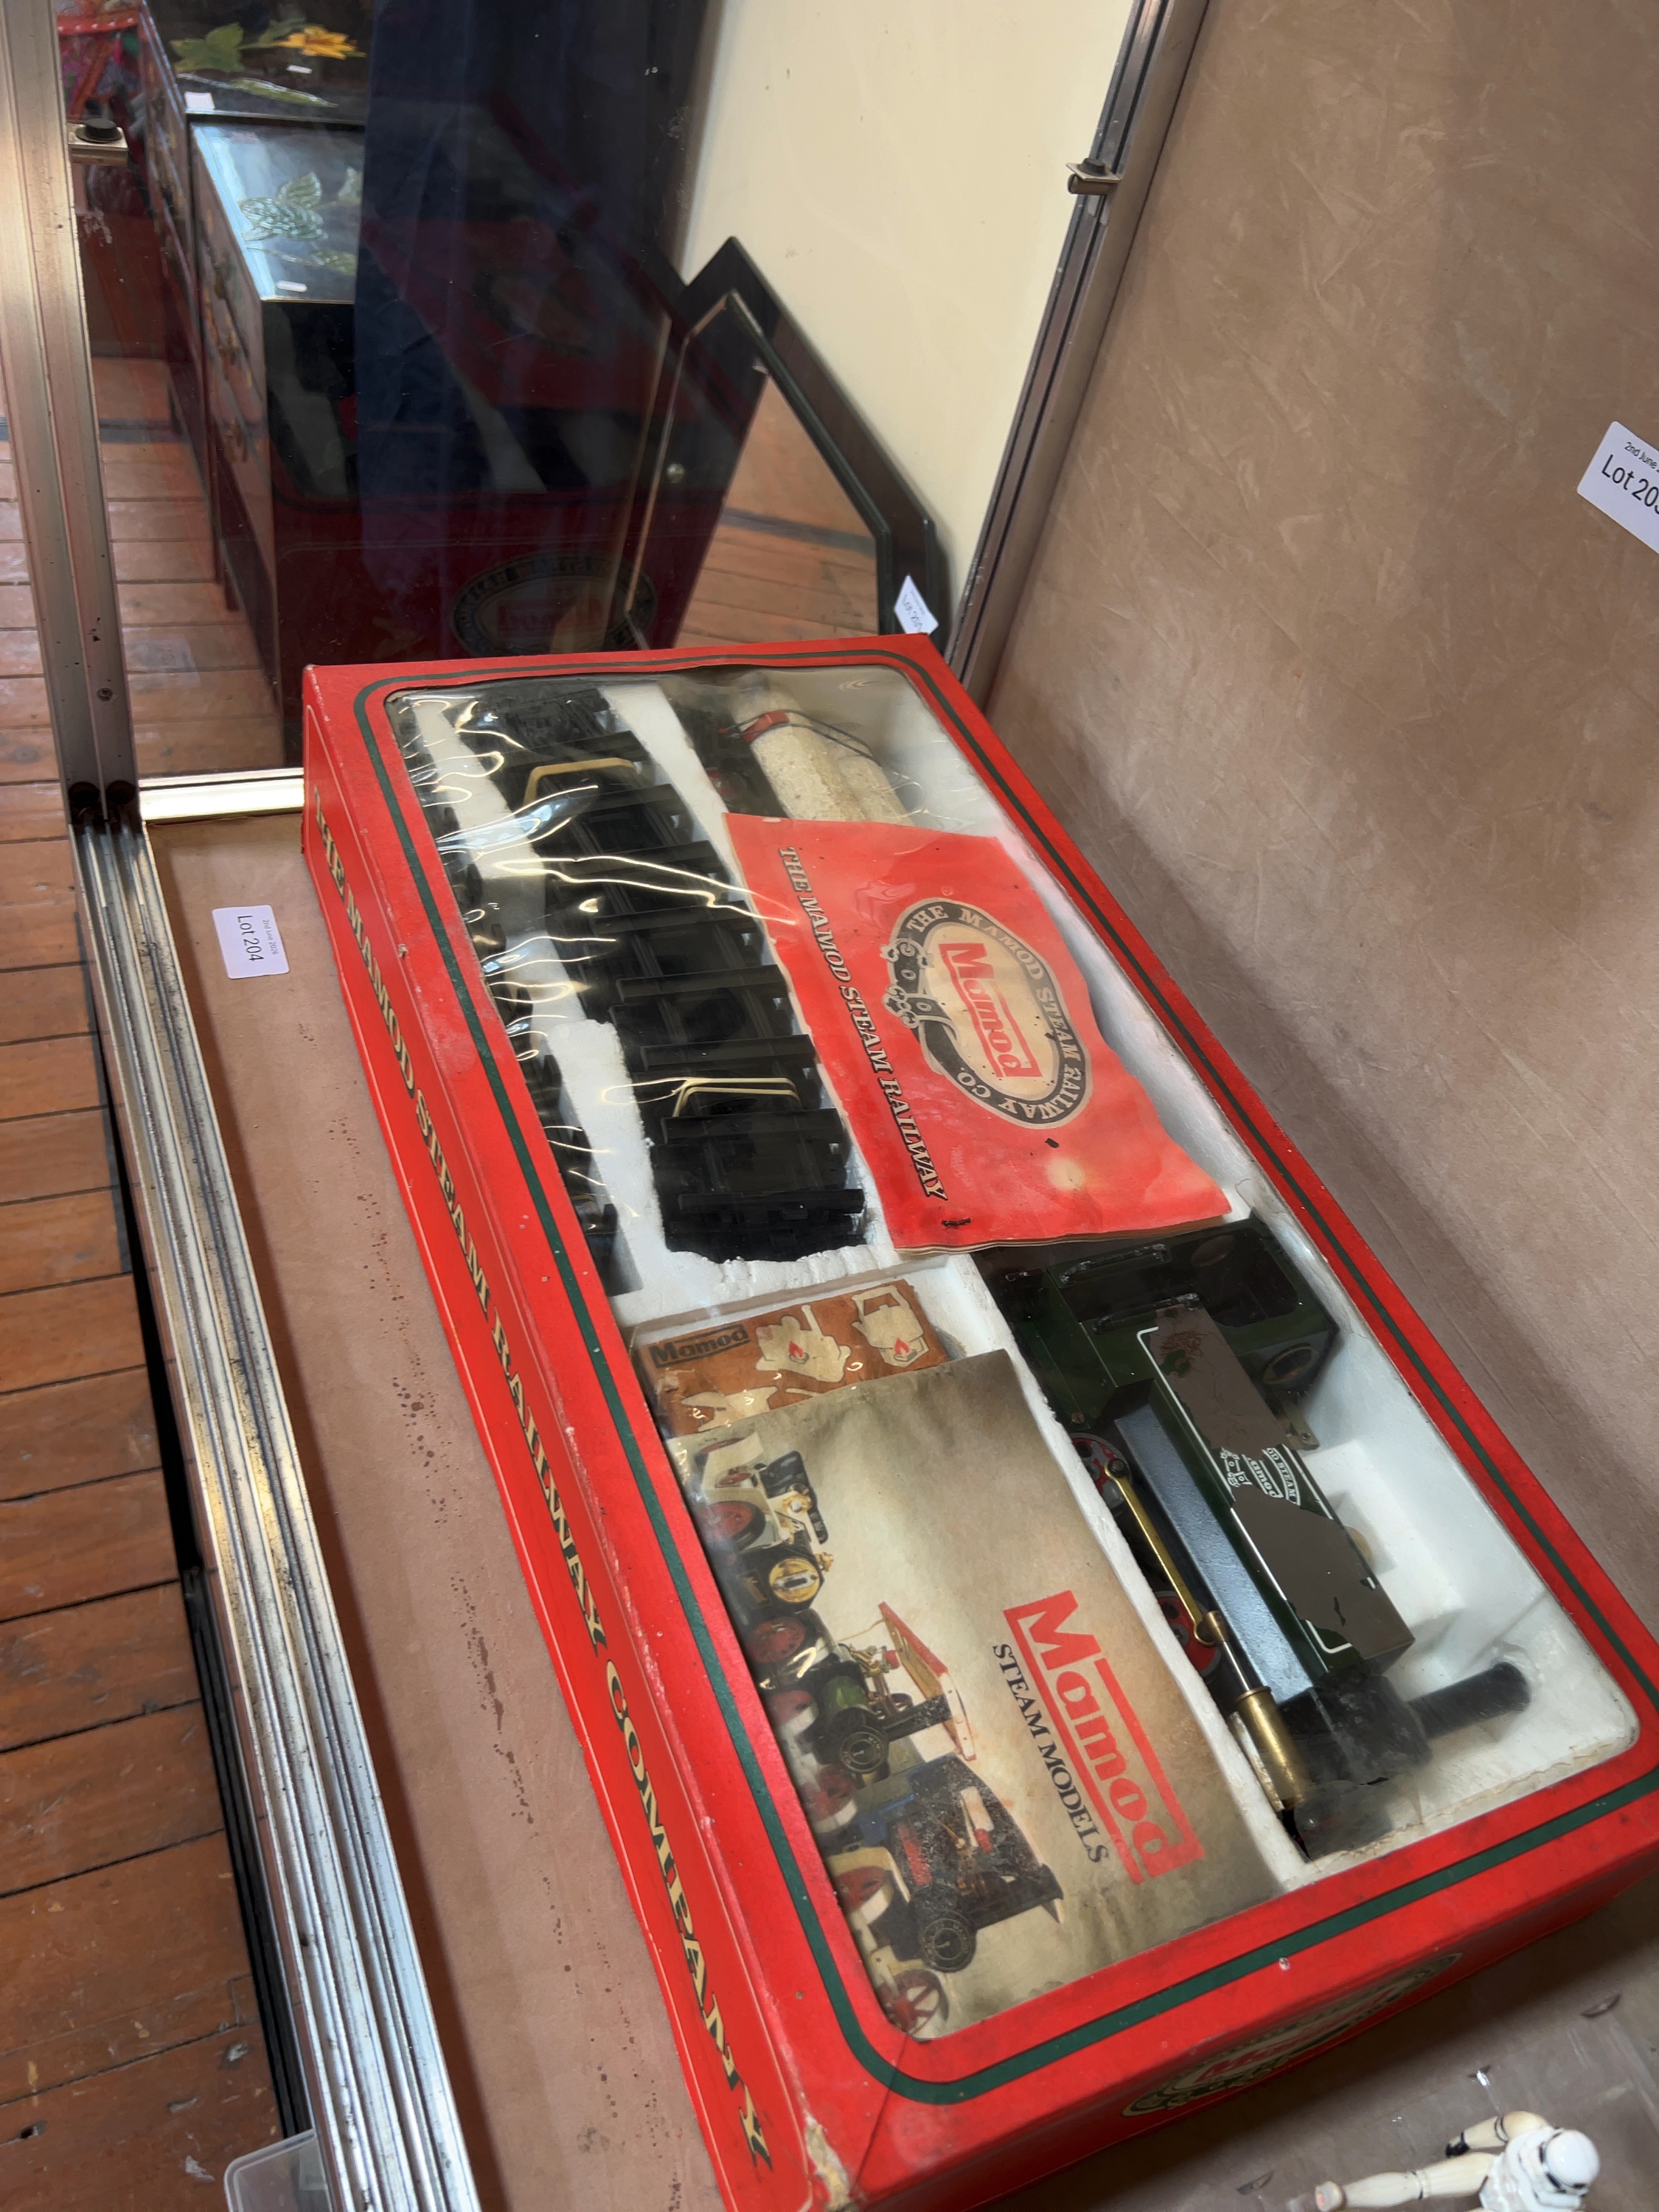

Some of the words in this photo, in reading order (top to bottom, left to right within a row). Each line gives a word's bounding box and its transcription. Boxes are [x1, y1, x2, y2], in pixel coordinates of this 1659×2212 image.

[1601, 454, 1635, 491] Lot
[1624, 442, 1641, 457] 2nd
[1639, 452, 1658, 470] June
[237, 915, 256, 936] Lot
[907, 905, 949, 933] THE
[959, 908, 1046, 981] MAMOD
[243, 938, 265, 962] 204
[778, 846, 813, 894] THE
[798, 894, 852, 984] MAMOD
[839, 985, 894, 1074] STEAM
[879, 1077, 949, 1201] RAILWAY
[939, 942, 1044, 1078] Mamod
[1035, 987, 1082, 1062] STEAM
[998, 1063, 1083, 1120] RAILWAY
[648, 1324, 750, 1368] Mamod
[314, 785, 346, 904] THE
[347, 883, 417, 1099] MAMOD
[416, 1087, 490, 1323] STEAM
[491, 1305, 608, 1658] RAILWAY
[605, 1659, 773, 2172] COMPANY
[1277, 1461, 1296, 1497] STEAM
[992, 1643, 1051, 1739] STEAM
[1037, 1741, 1110, 1864] MODELS
[1002, 1589, 1206, 1885] Mamod
